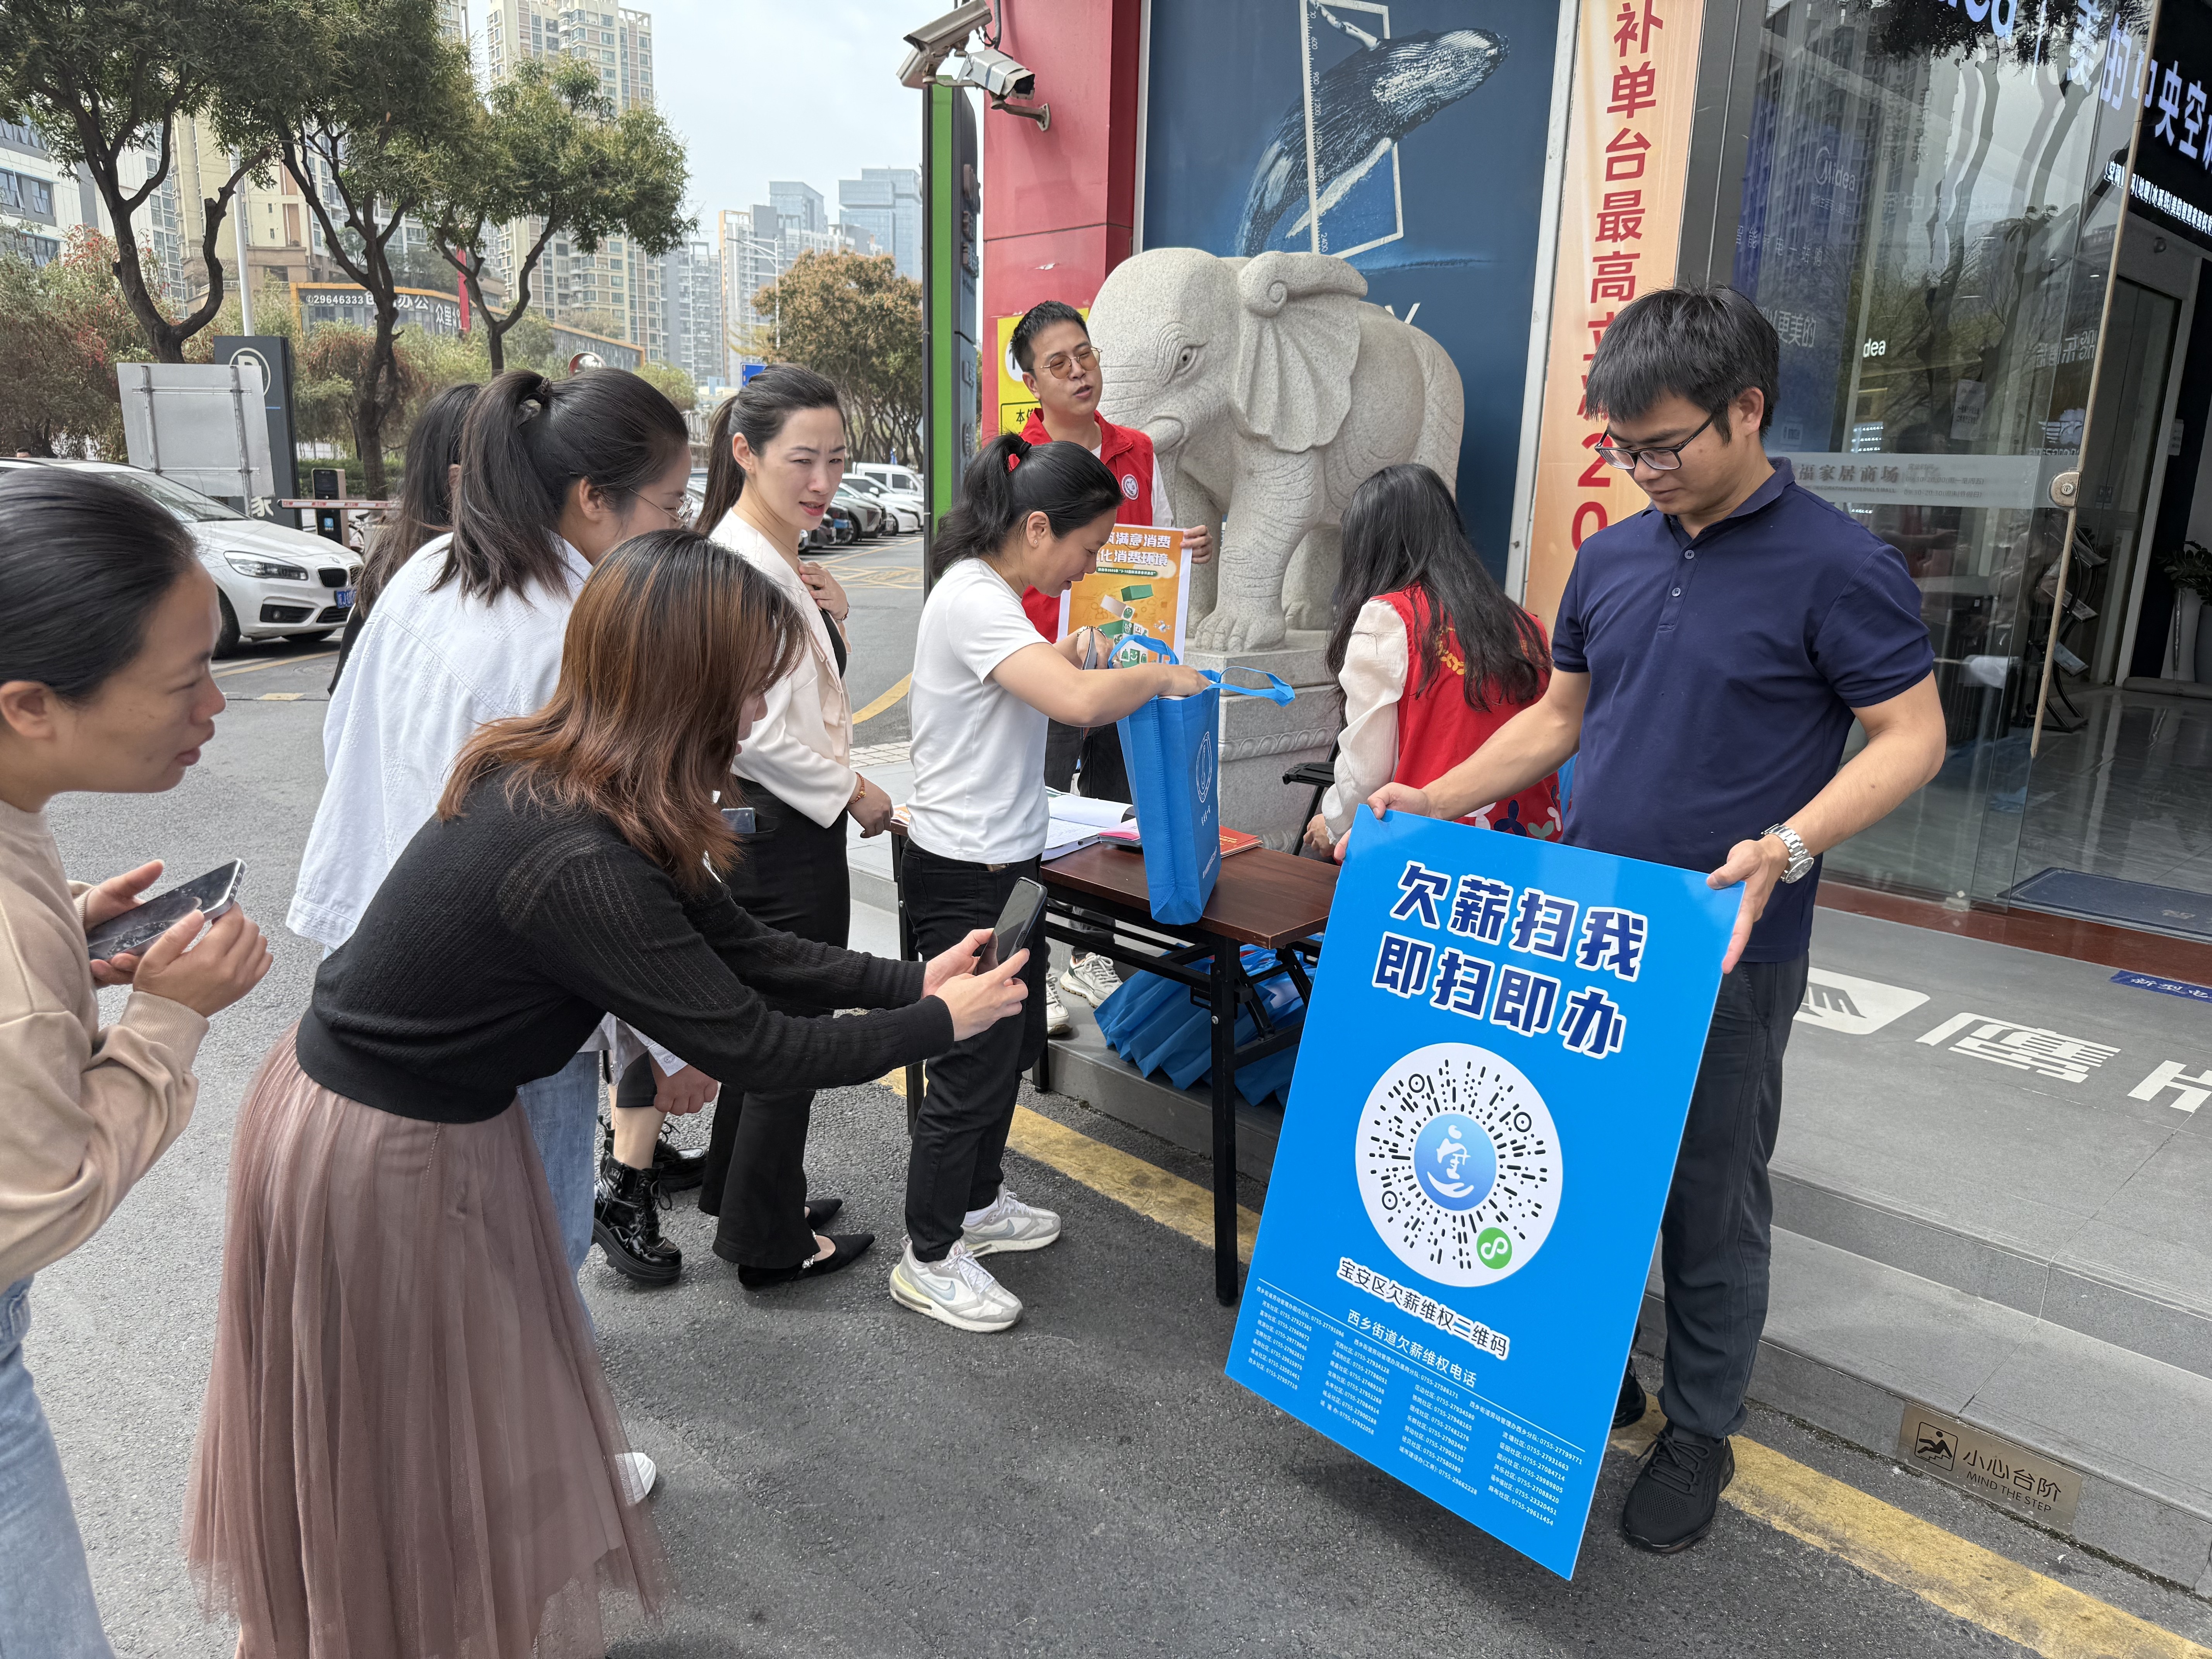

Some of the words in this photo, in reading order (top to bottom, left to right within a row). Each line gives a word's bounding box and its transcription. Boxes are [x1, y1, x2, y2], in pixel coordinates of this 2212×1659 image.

[1814, 146, 1856, 192] Midea
[314, 294, 364, 305] 29646333
[1097, 548, 1168, 567] 化消费环境
[1389, 860, 1647, 982] 欠薪扫我
[1372, 931, 1626, 1059] 即扫即办
[1336, 1257, 1510, 1360] 宝安区欠薪维权二维码
[1347, 1309, 1476, 1388] 西乡街道欠薪维权电话
[1963, 1449, 2061, 1502] 小心台阶
[1966, 1471, 1997, 1490] MIND
[2001, 1485, 2021, 1502] THE
[2025, 1496, 2051, 1513] STEP
